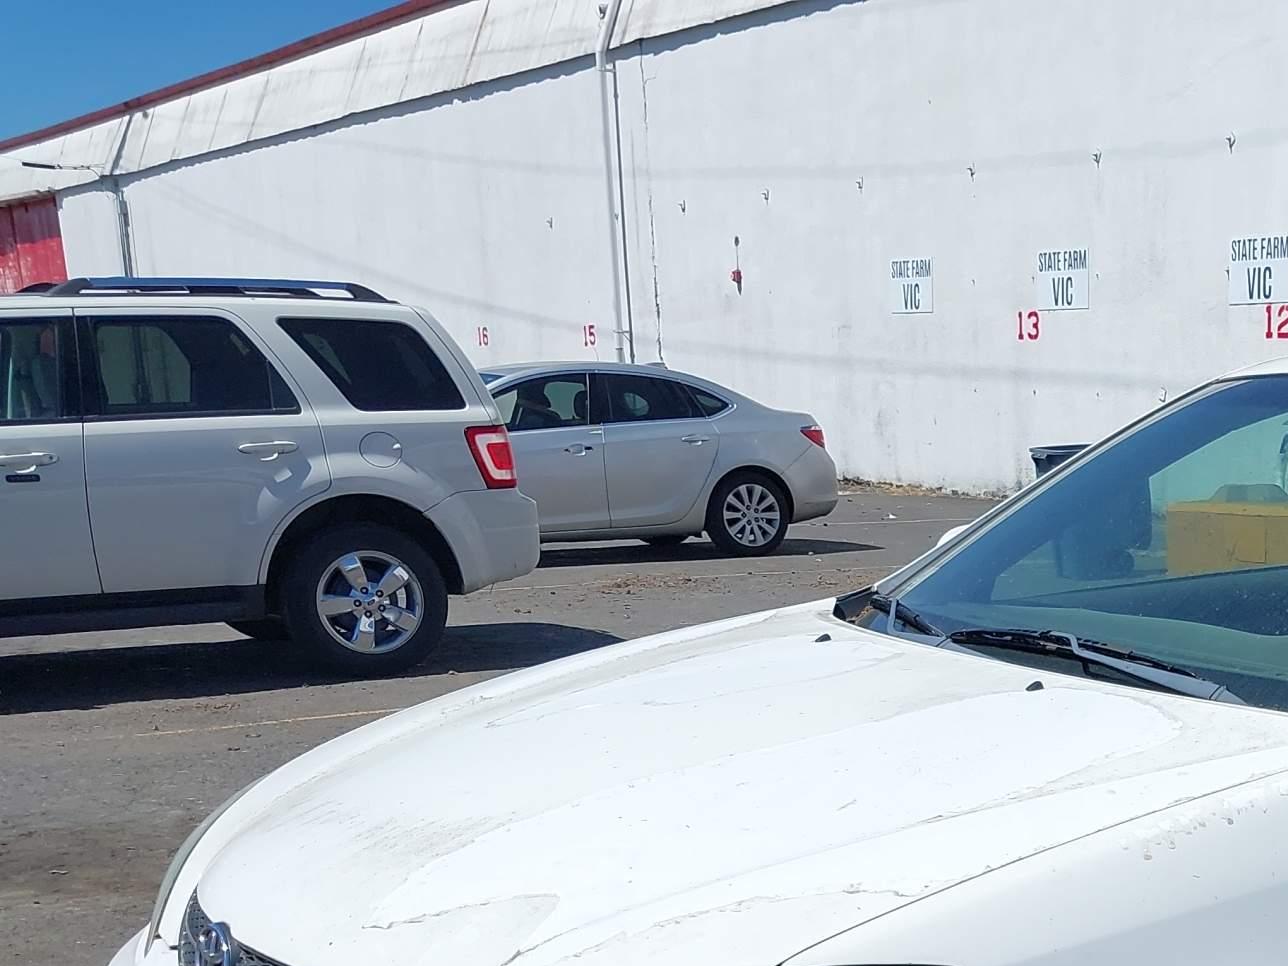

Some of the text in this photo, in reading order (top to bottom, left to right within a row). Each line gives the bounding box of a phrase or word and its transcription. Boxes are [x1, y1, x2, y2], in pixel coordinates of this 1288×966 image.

[1038, 249, 1087, 273] STATE FARM
[1231, 236, 1288, 262] STATE FARM
[891, 258, 931, 279] STATE FARM
[1052, 276, 1073, 307] VIC
[1247, 266, 1272, 300] VIC
[902, 283, 920, 310] VIC
[477, 326, 489, 346] 16
[583, 325, 596, 347] 15
[1018, 311, 1040, 340] 13
